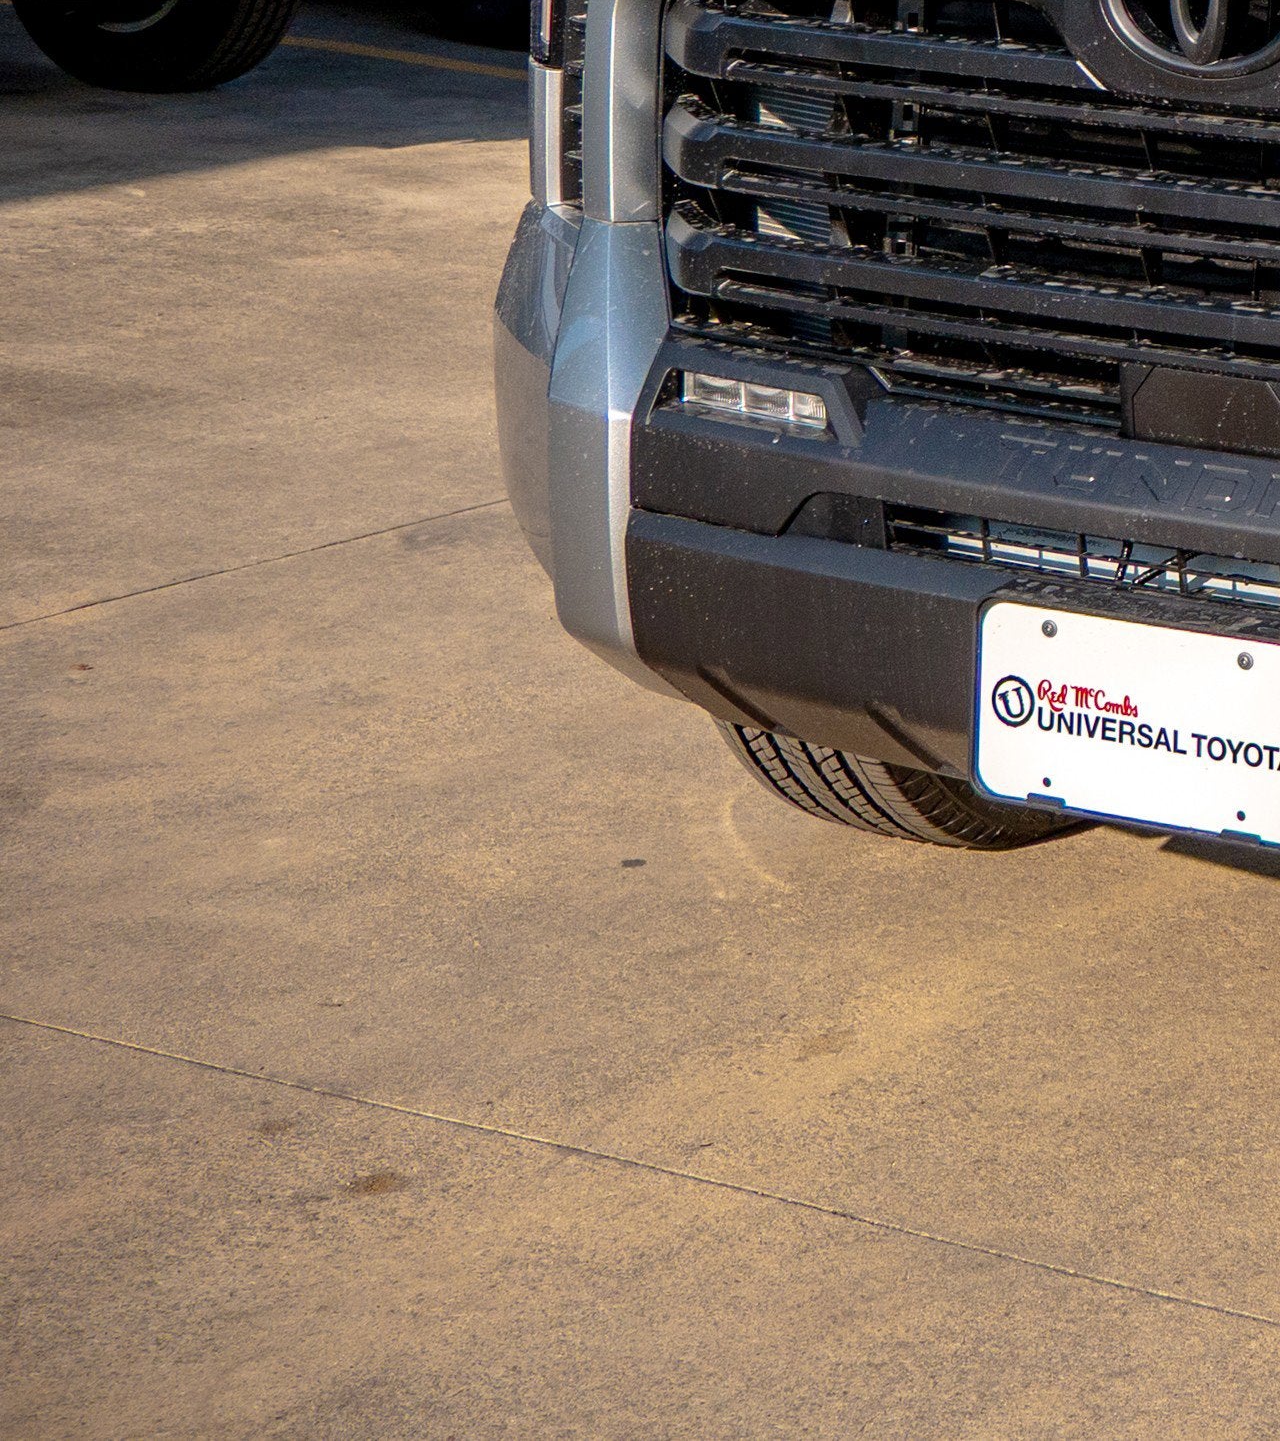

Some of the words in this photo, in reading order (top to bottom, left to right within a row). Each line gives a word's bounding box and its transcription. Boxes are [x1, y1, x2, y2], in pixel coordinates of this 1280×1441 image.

[1037, 679, 1068, 712] Red
[1071, 685, 1139, 718] McCombs
[1037, 706, 1188, 755] UNIVERSAL
